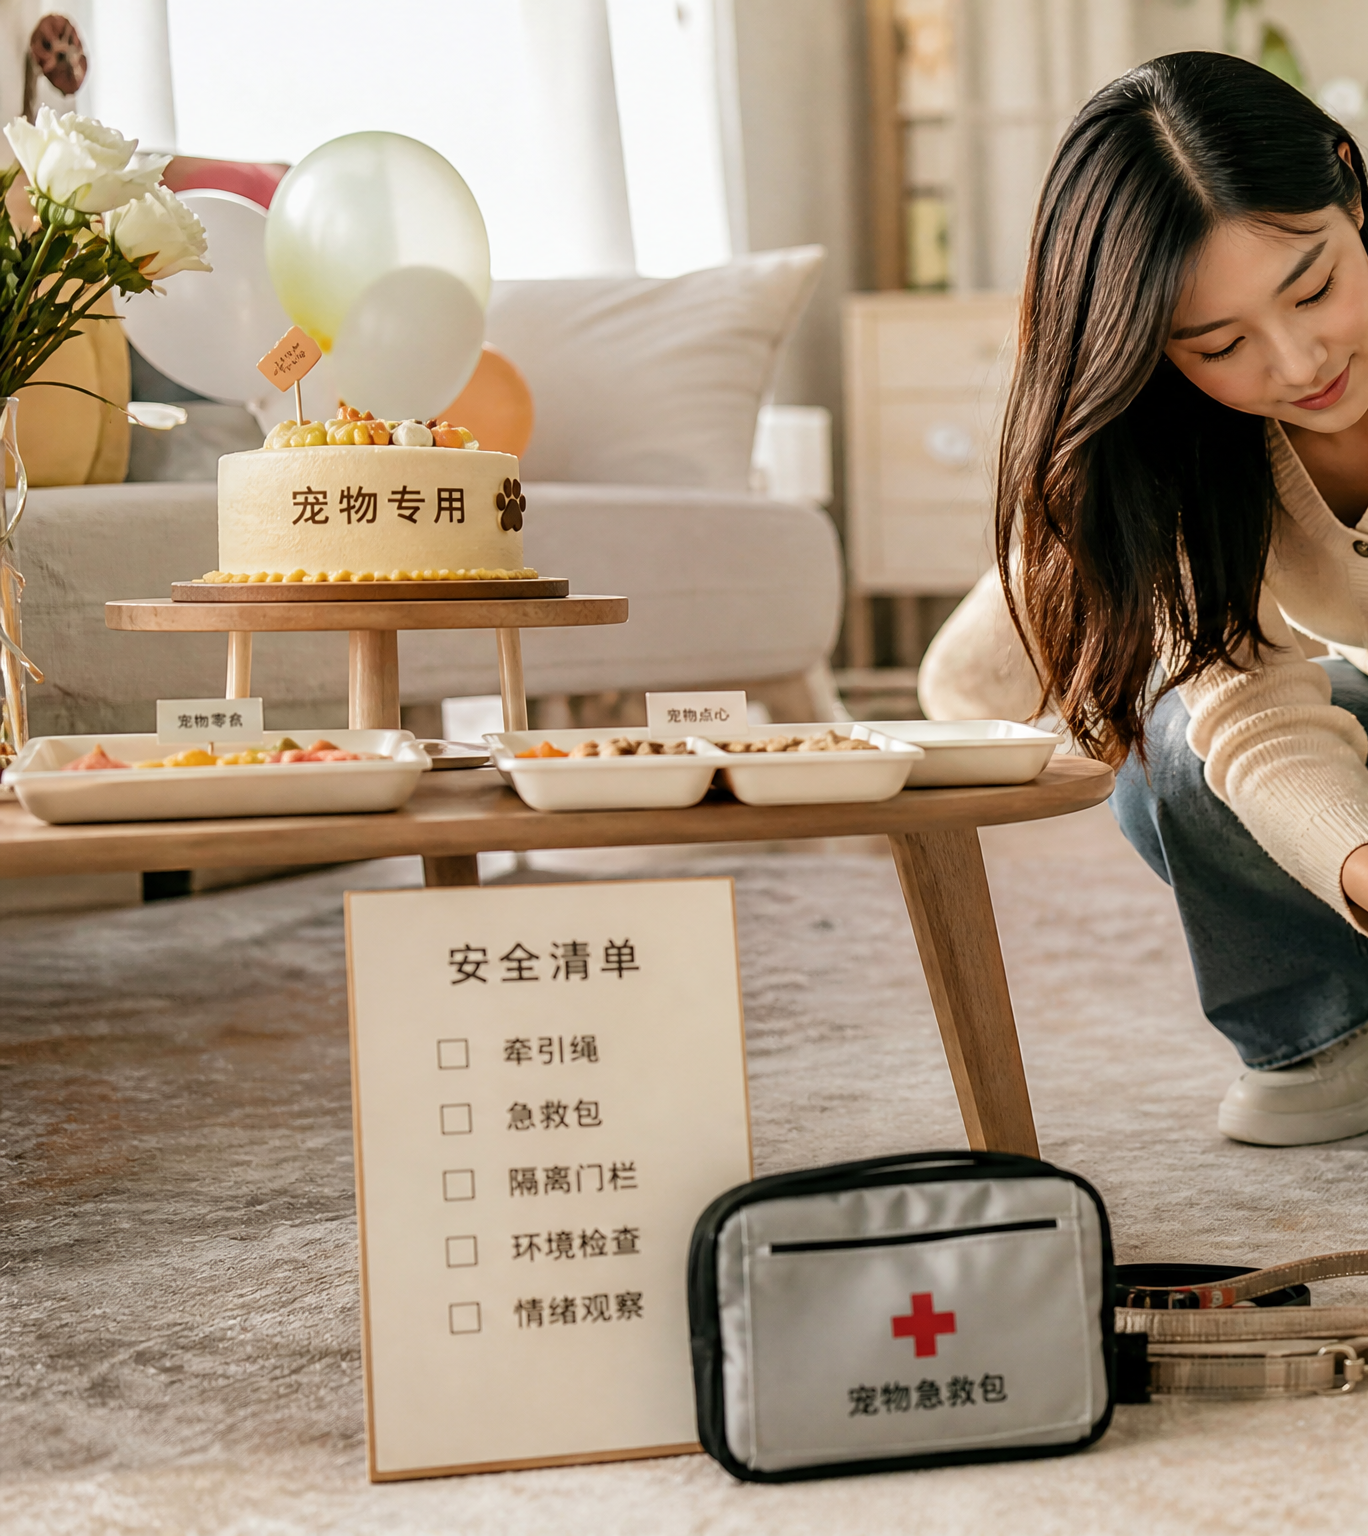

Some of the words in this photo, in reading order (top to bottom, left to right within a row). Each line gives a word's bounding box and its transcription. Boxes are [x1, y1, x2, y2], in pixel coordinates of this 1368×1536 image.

[291, 484, 466, 526] 宠物专用
[666, 707, 730, 724] 宠物点心
[448, 938, 641, 986] 安全清单
[503, 1034, 600, 1066] 牵引绳
[506, 1098, 603, 1131] 急救包
[508, 1161, 638, 1197] 隔离门栏
[511, 1225, 641, 1262] 环境检查
[514, 1290, 644, 1328] 情绪观察
[848, 1372, 1008, 1417] 宠物急救包
